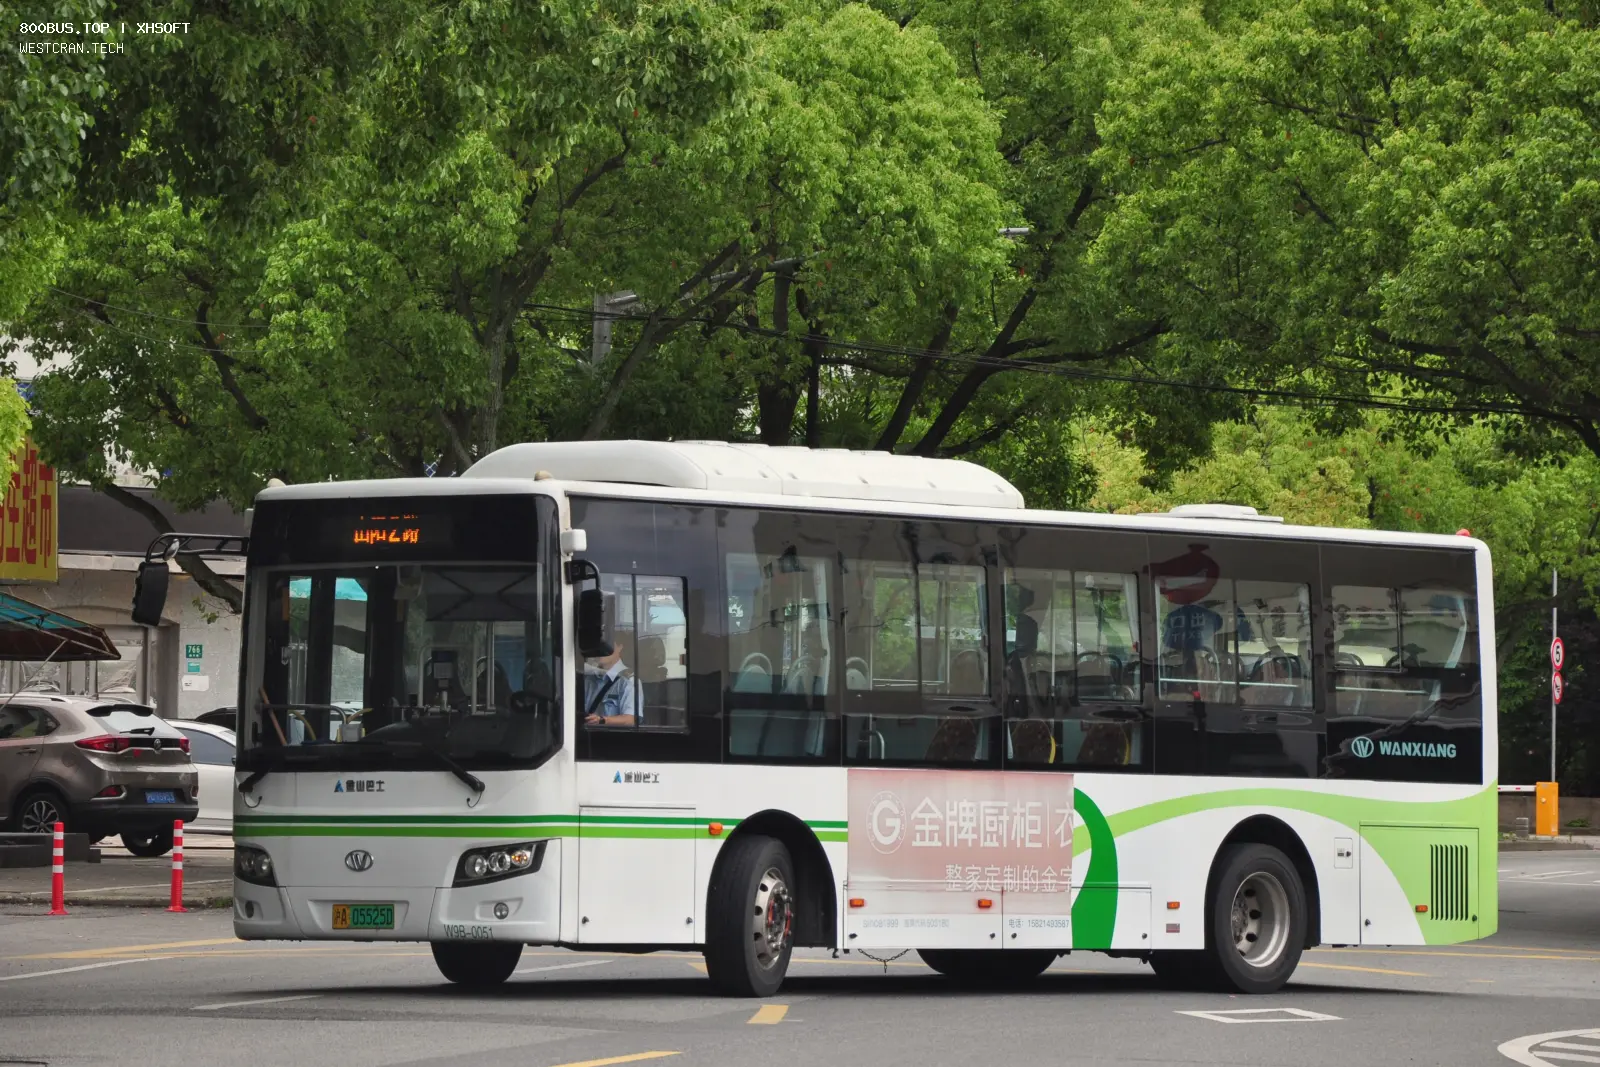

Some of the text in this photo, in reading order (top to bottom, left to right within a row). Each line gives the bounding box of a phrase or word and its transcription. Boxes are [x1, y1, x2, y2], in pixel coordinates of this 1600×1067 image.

[0, 443, 53, 569] 生超市
[1555, 645, 1561, 663] 5
[1379, 741, 1457, 758] WANXIANG
[444, 924, 494, 940] W9B-0051
